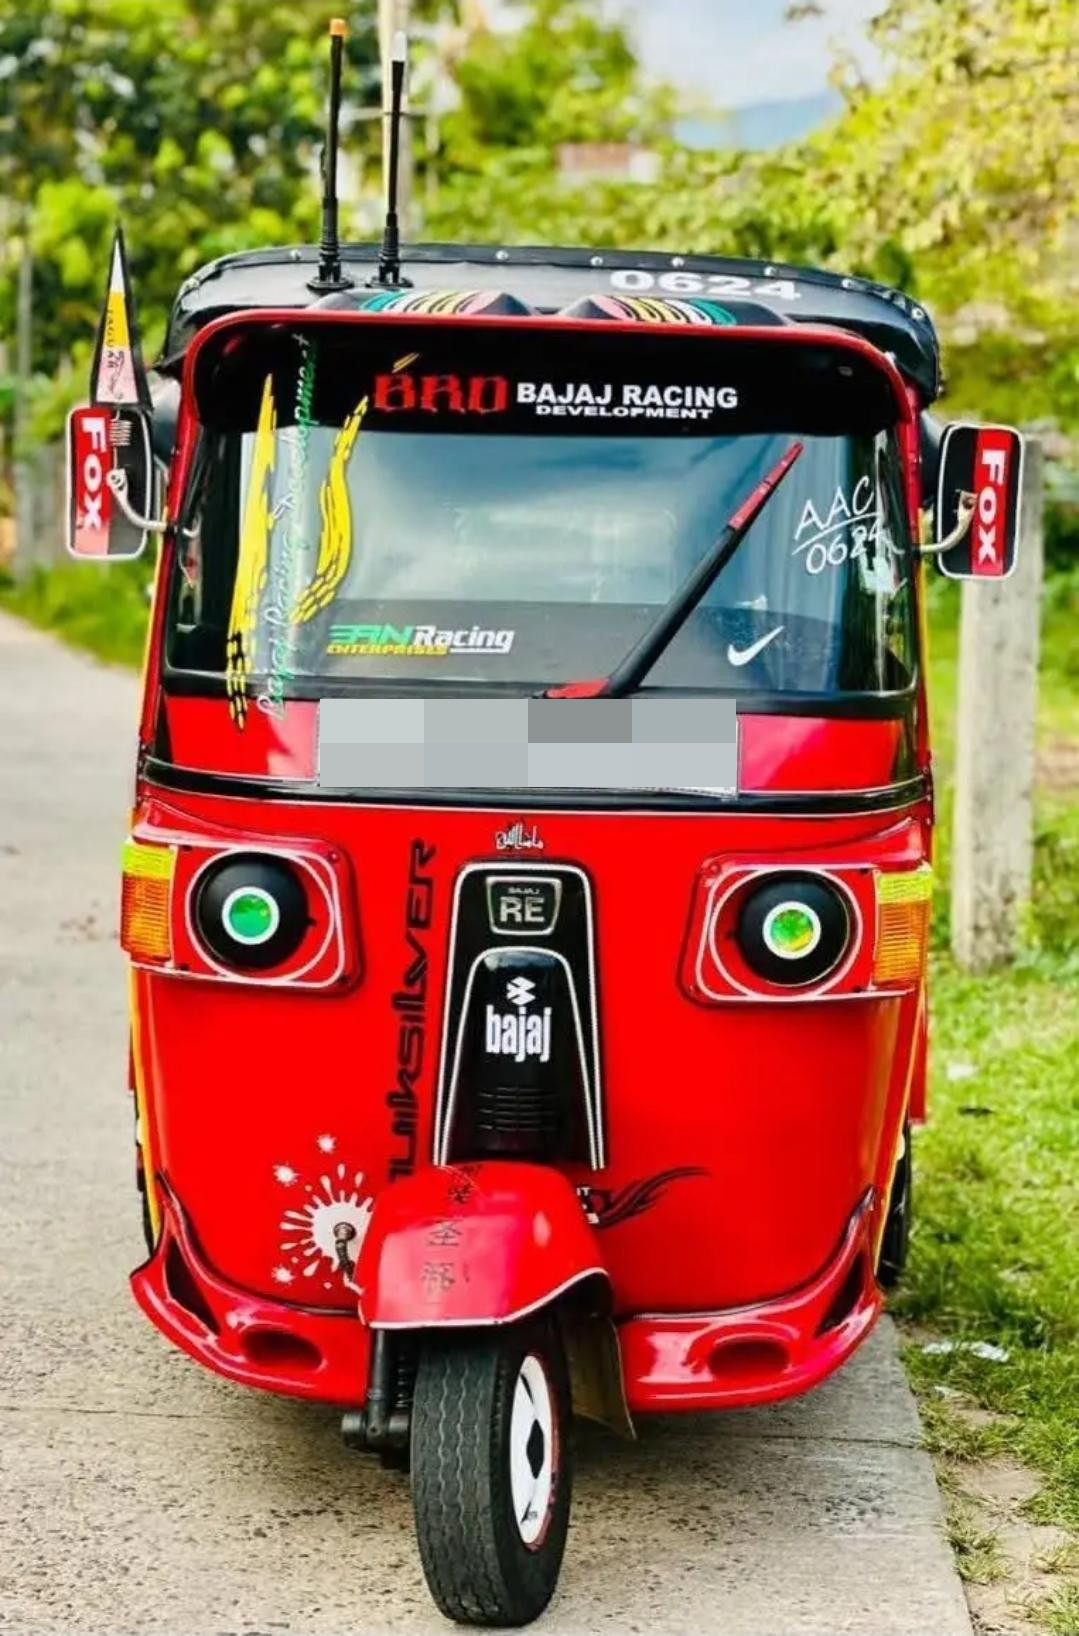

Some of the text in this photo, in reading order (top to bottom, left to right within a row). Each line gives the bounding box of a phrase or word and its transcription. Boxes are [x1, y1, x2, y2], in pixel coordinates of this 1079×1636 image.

[609, 269, 800, 300] 0624
[516, 382, 739, 409] BAJAJ RACING
[535, 405, 714, 420] DEVELOPMENT
[81, 416, 107, 530] FOX
[794, 475, 875, 541] AAC
[977, 449, 1007, 567] FOX
[412, 625, 515, 654] Racing
[500, 896, 545, 922] RE
[485, 1004, 552, 1063] bajaj
